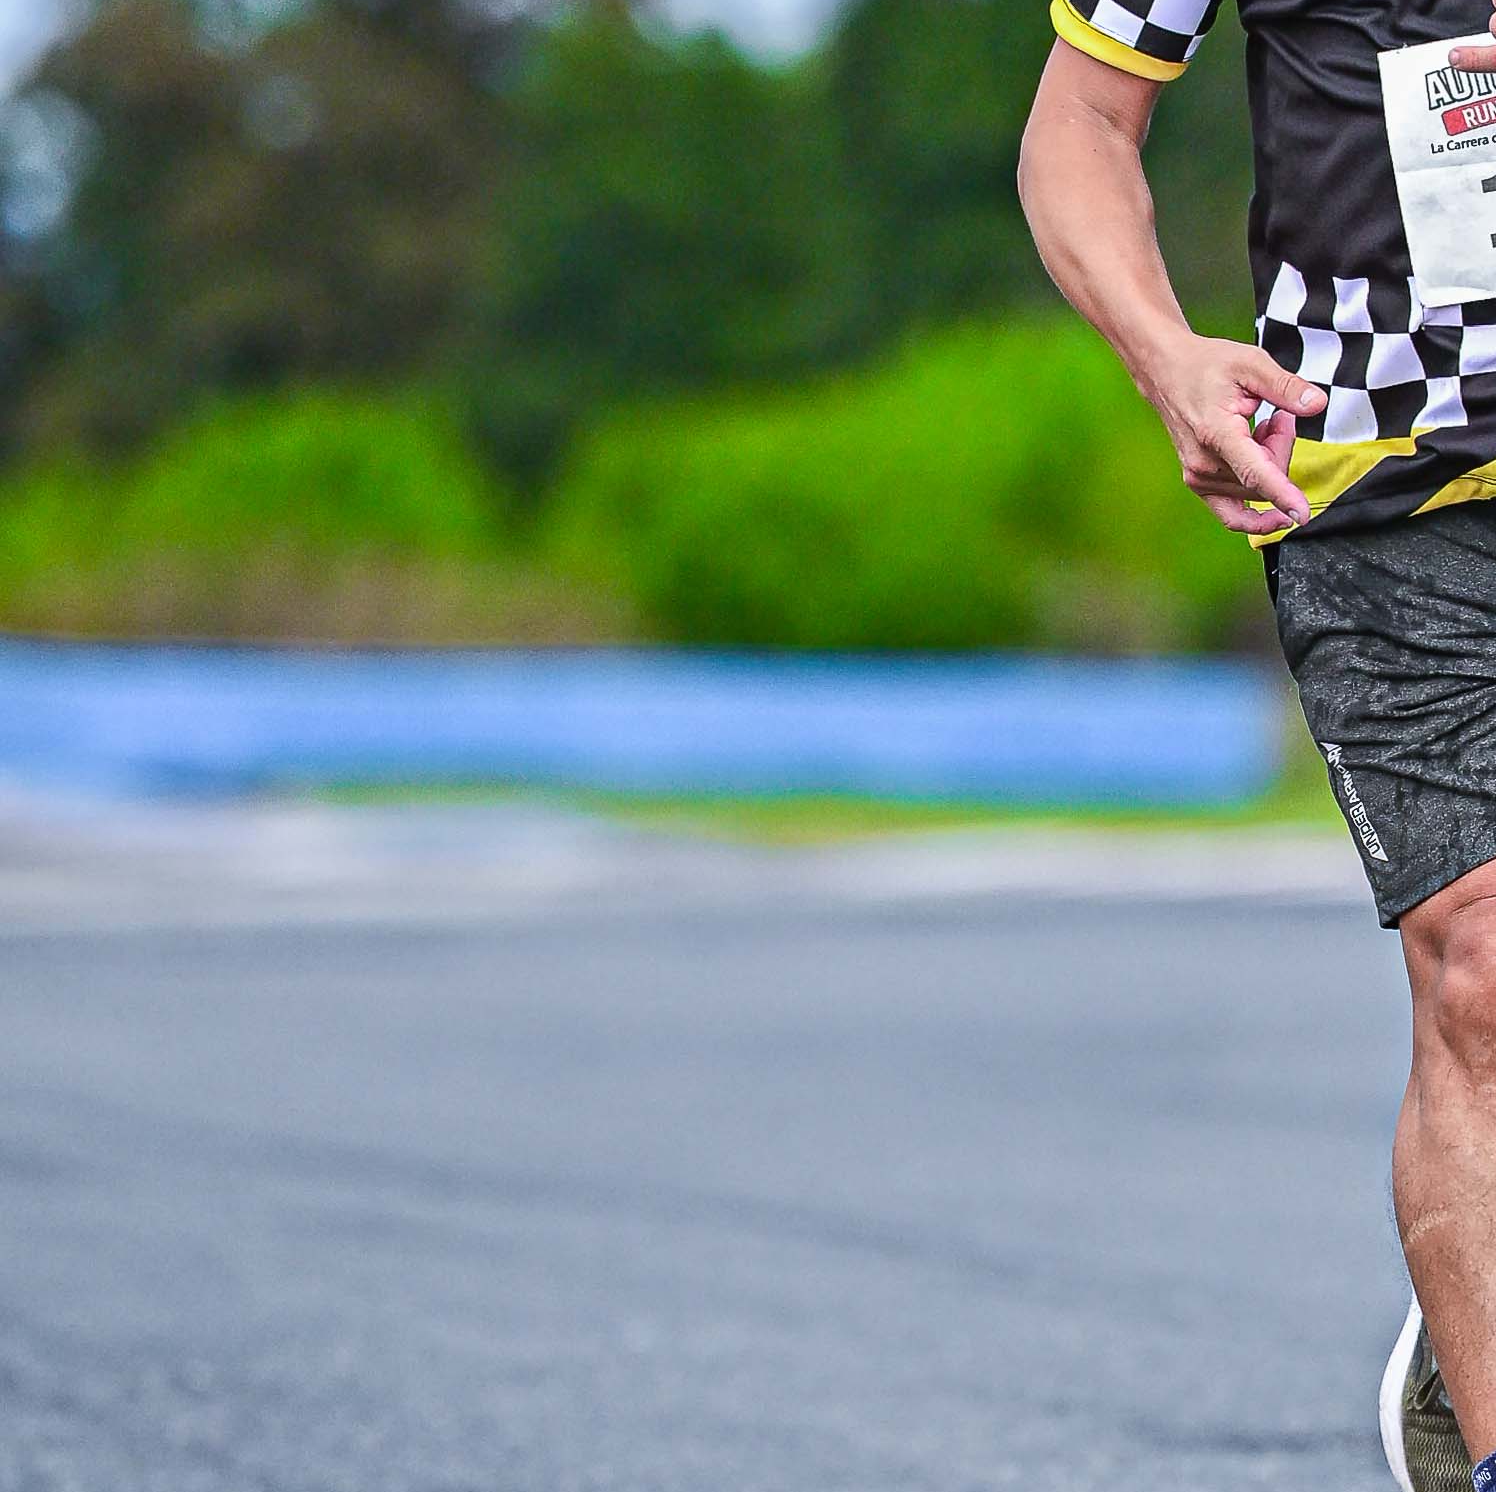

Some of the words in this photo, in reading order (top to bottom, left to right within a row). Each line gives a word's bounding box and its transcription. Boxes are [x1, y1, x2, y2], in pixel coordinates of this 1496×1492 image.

[1430, 142, 1445, 155] La
[1446, 136, 1490, 151] Carrera
[1351, 801, 1381, 855] UNDER
